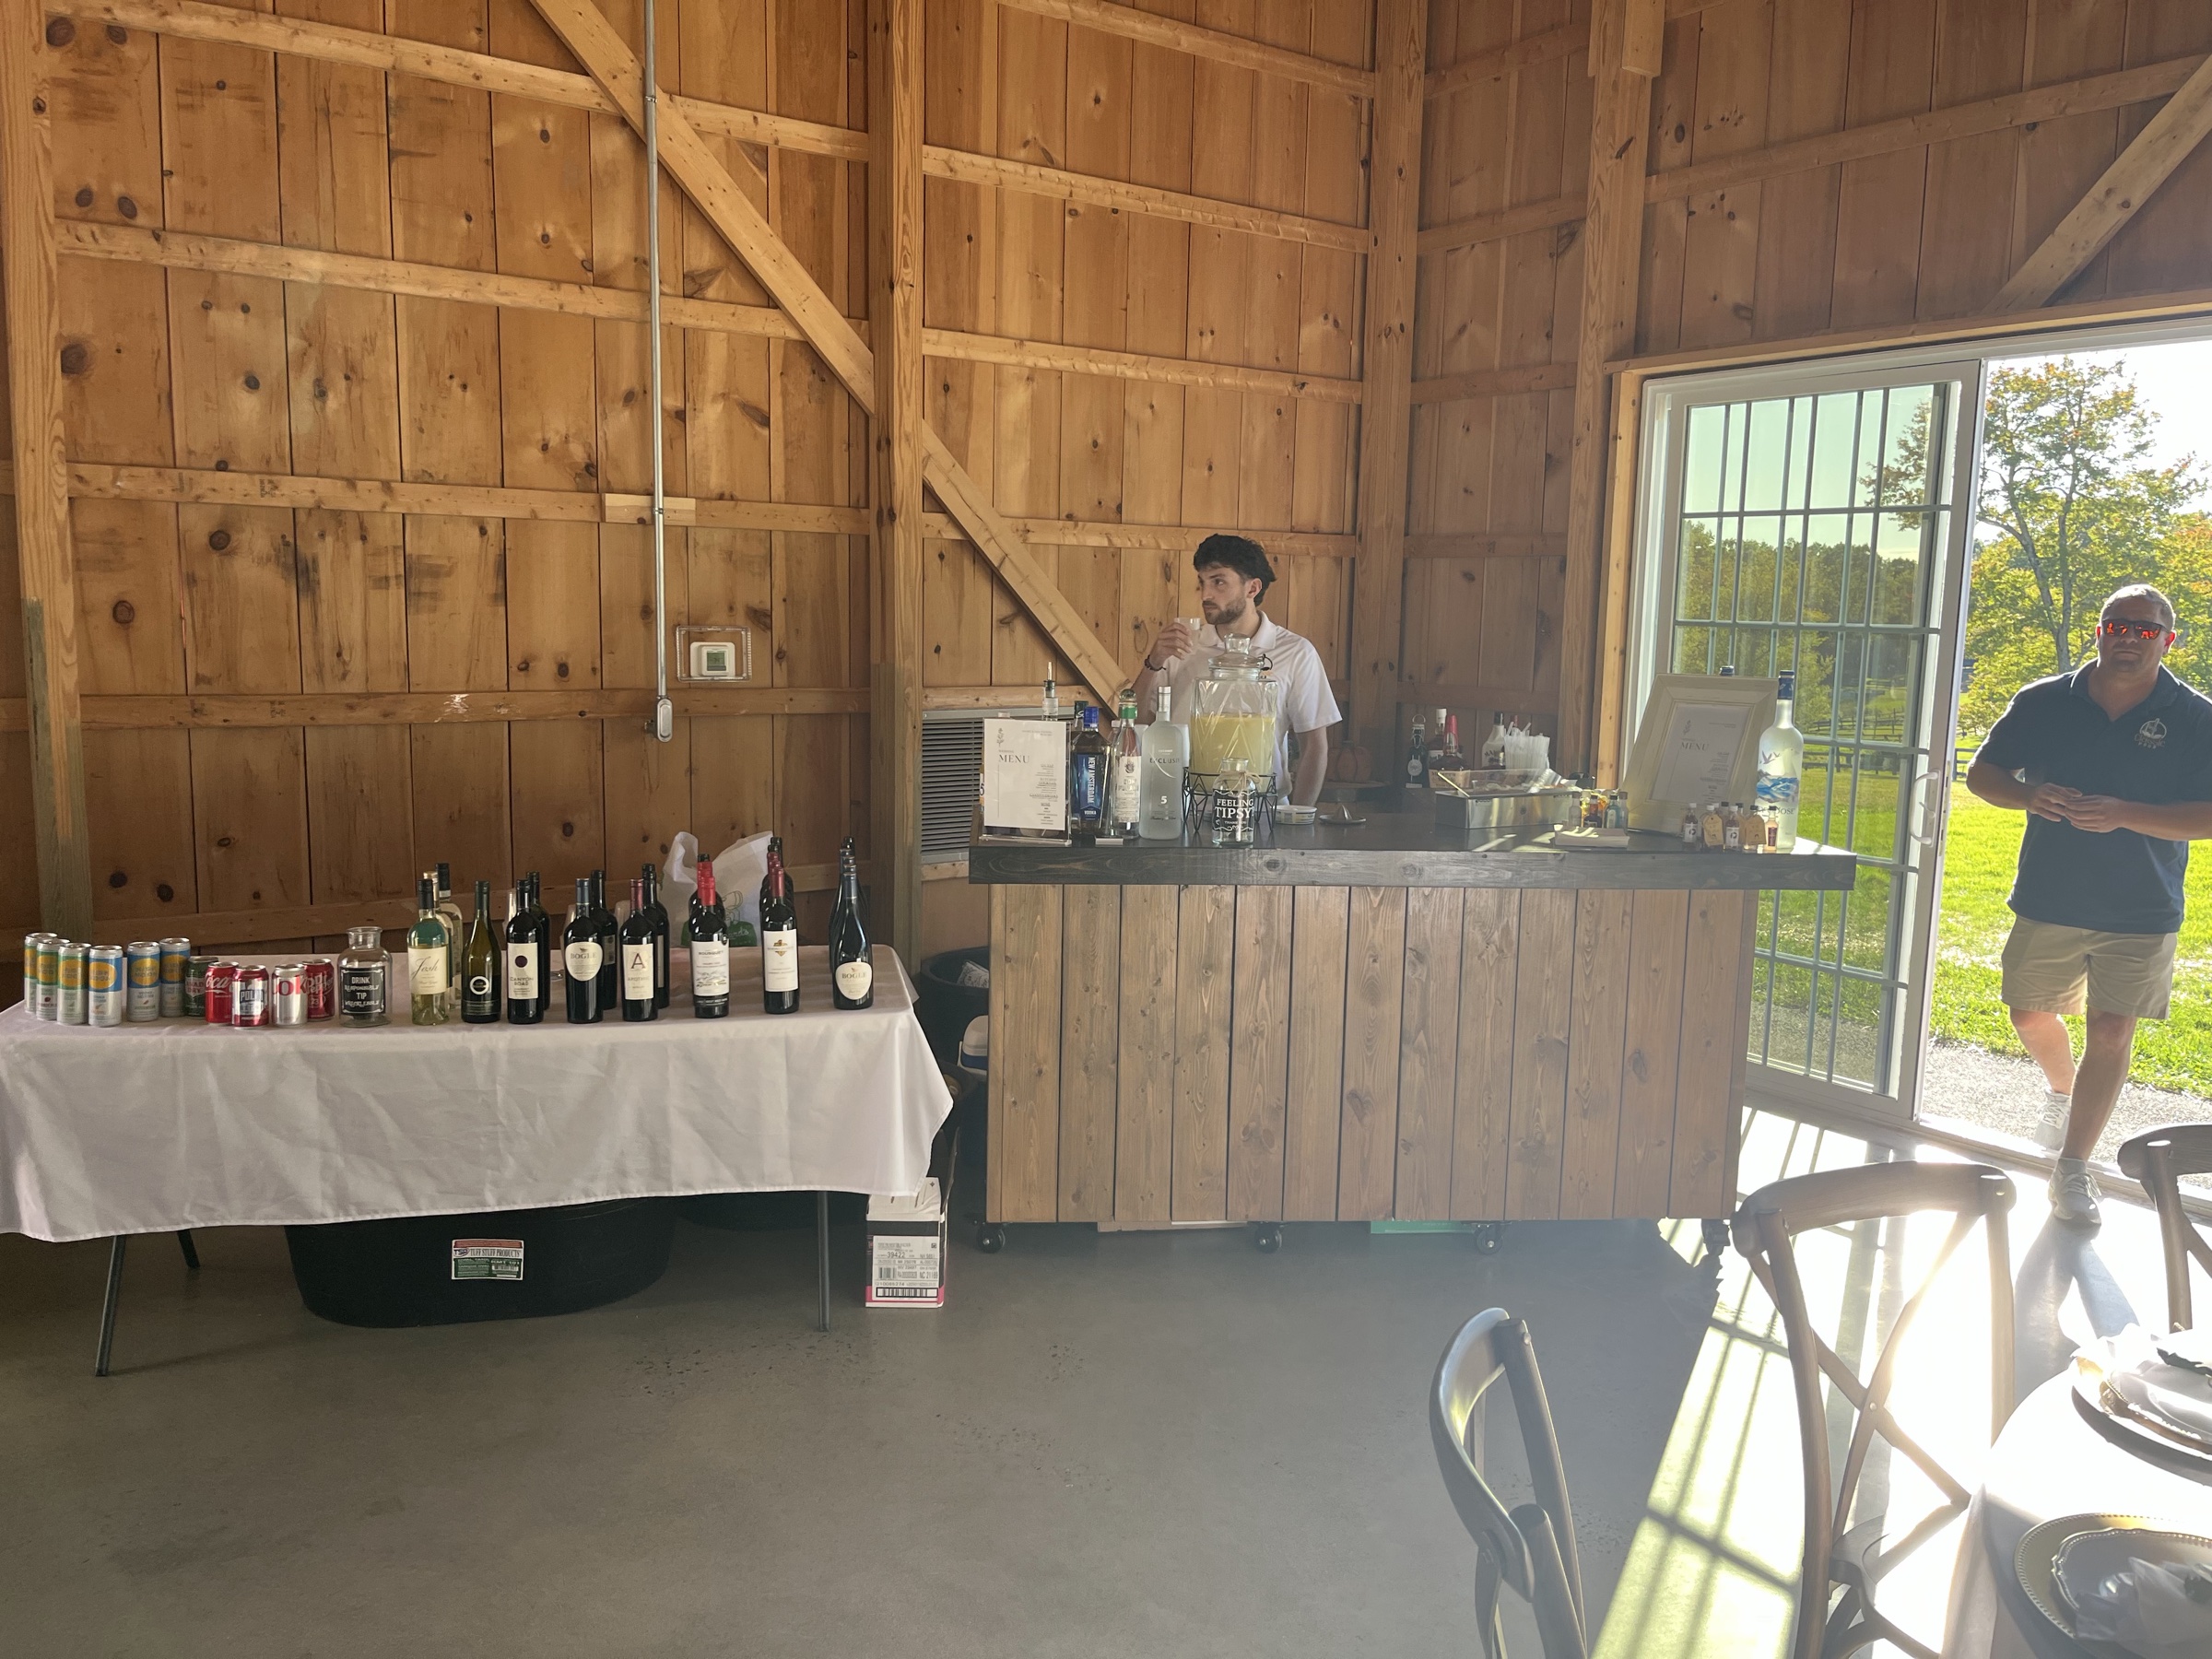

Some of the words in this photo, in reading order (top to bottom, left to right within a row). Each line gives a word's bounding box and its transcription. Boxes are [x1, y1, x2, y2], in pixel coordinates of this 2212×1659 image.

[1681, 742, 1710, 752] MENU
[998, 754, 1030, 764] MENU
[1088, 757, 1096, 770] NEW
[1088, 771, 1096, 804] AMSTERDAM
[1160, 795, 1168, 805] 5
[1217, 798, 1253, 807] FEELING
[630, 953, 646, 970] A
[411, 956, 440, 981] Josh
[497, 1249, 520, 1258] PRODUCTS
